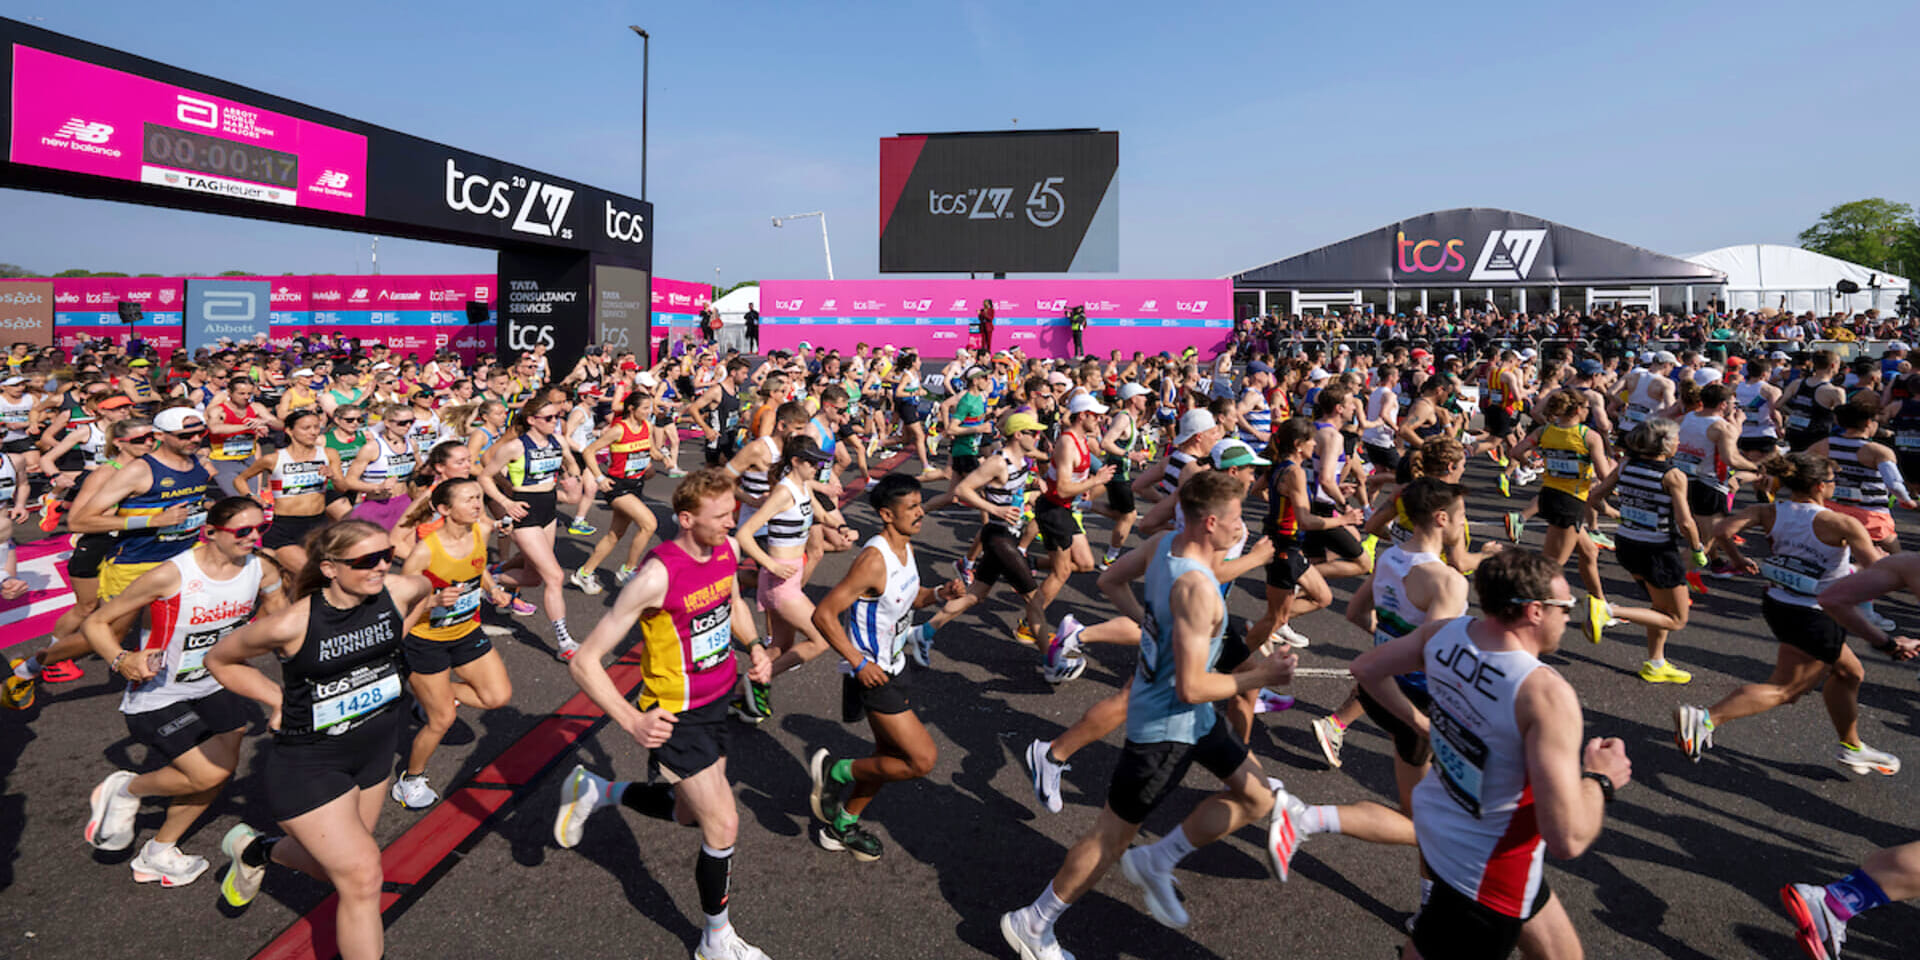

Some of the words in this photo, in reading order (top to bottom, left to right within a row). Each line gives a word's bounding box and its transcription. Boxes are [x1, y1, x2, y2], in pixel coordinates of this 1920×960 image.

[223, 106, 258, 120] ABBOTT
[223, 113, 255, 126] WORLD
[223, 119, 274, 137] MARATHON
[223, 125, 260, 139] MAJORS
[41, 136, 69, 148] new
[70, 140, 121, 158] balance
[149, 132, 296, 182] 00:00:17
[324, 187, 353, 198] balance
[446, 159, 510, 219] tcs
[512, 175, 527, 189] 20
[561, 228, 574, 240] 25
[929, 189, 967, 215] tcs
[605, 199, 643, 243] tcs
[1397, 231, 1466, 273] tcs
[510, 281, 539, 291] TATA
[509, 292, 577, 303] CONSULTANCY
[509, 303, 552, 314] SERVICES
[203, 323, 254, 333] Abbott
[508, 319, 554, 350] tcs
[601, 322, 629, 348] tcs
[692, 614, 716, 633] tcs
[188, 633, 217, 649] tcs
[319, 621, 391, 651] MIDNIGHT
[319, 630, 394, 663] RUNNERS
[1436, 644, 1506, 702] JOE
[317, 677, 350, 698] tcs
[336, 687, 383, 717] 1428
